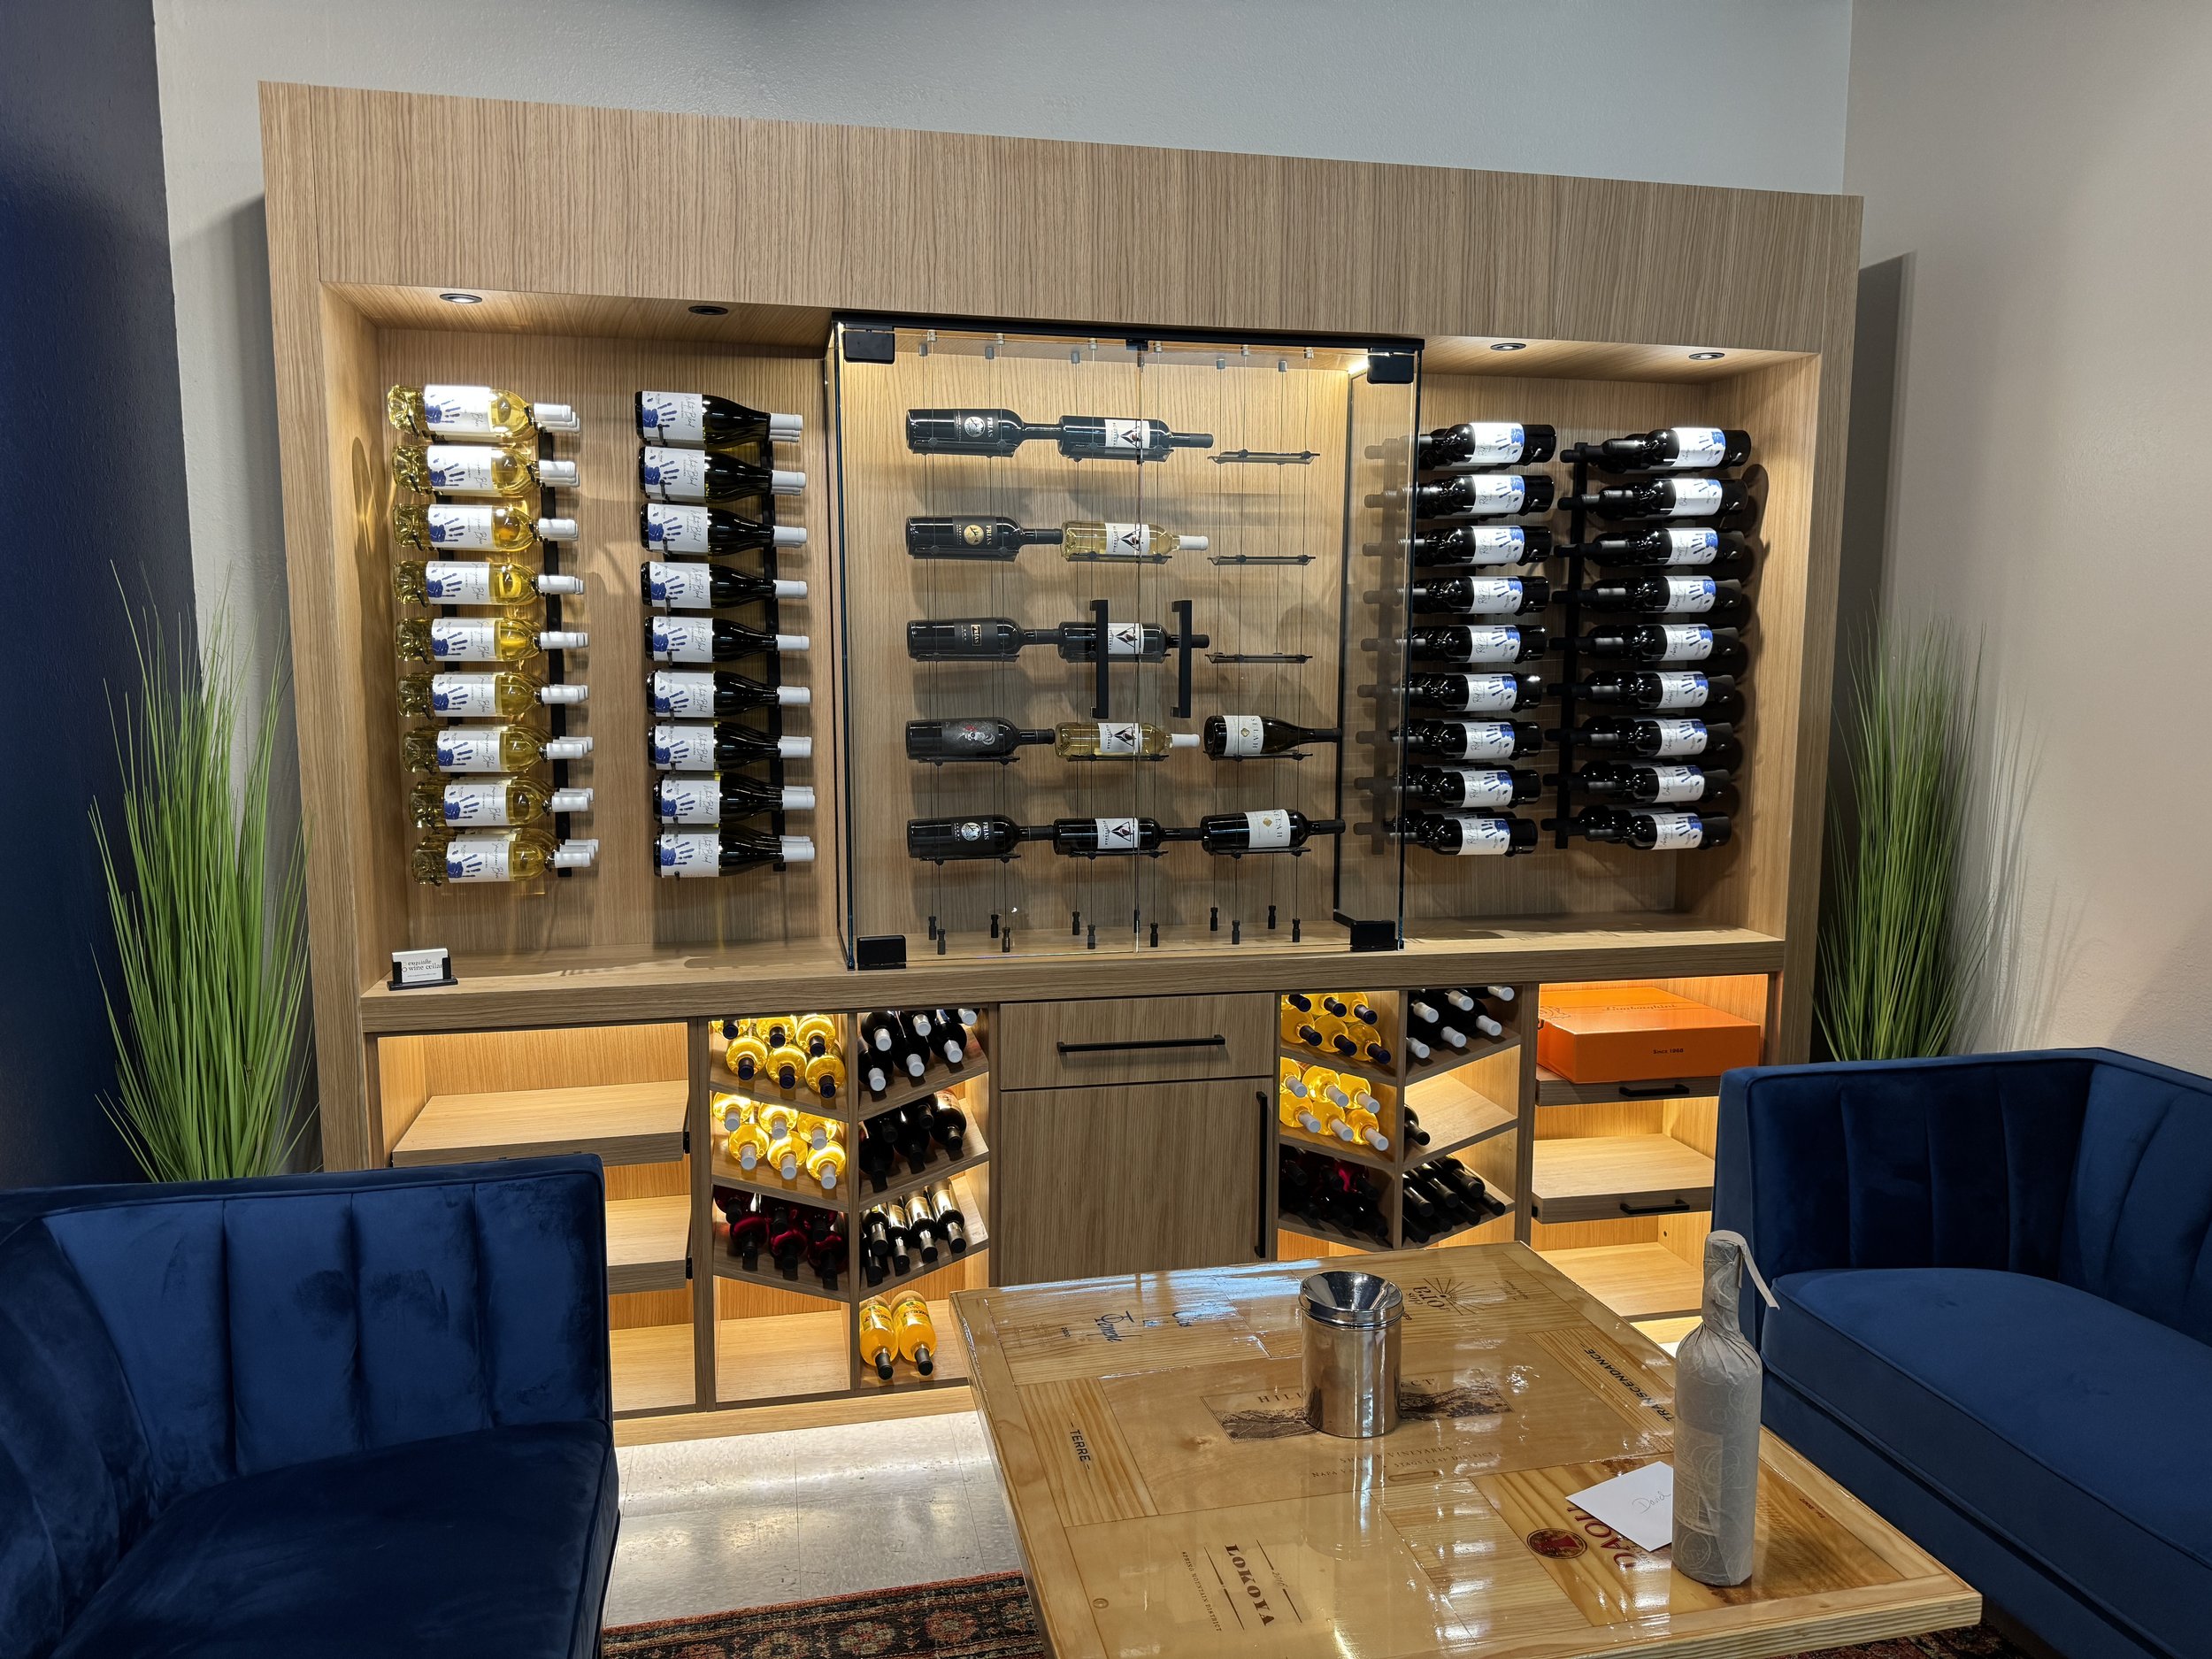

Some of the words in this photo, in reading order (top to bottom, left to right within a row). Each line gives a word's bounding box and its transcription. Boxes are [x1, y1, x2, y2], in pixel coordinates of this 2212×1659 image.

[1584, 1348, 1674, 1422] TRANSCENDANCE
[1070, 1429, 1091, 1462] TERRE
[1632, 1490, 1671, 1514] David
[1225, 1544, 1275, 1626] LOKOYA
